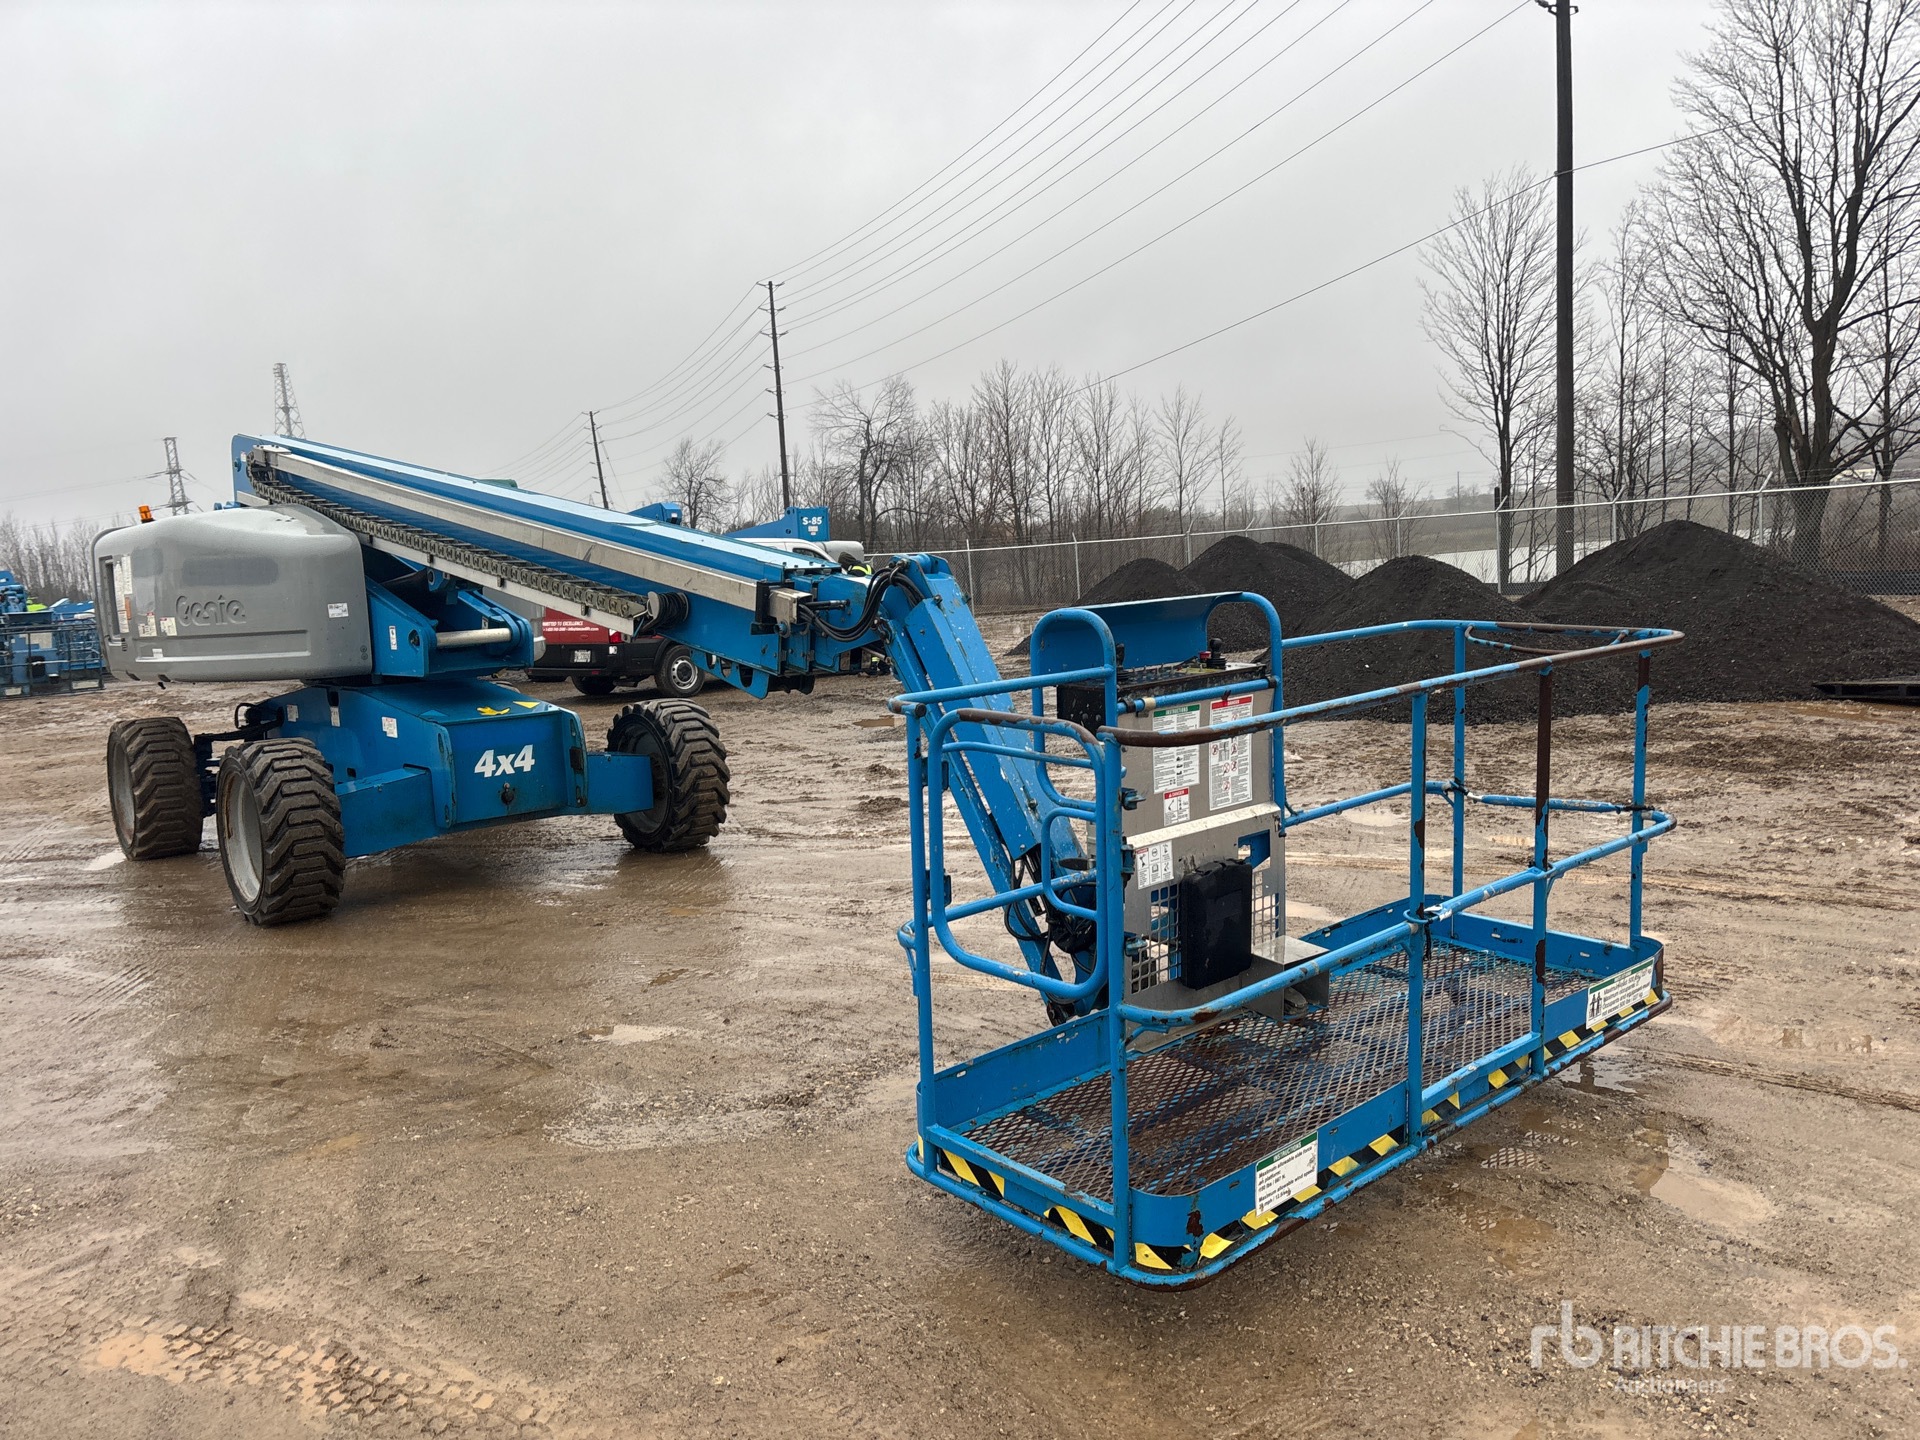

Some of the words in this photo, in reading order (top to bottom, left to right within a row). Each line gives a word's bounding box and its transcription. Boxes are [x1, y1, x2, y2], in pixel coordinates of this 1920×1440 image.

[802, 516, 822, 525] S-85
[176, 595, 246, 627] Genie
[1166, 706, 1188, 715] INSTRUCTIONS
[474, 744, 535, 778] 4x4
[1259, 1166, 1277, 1178] Maximum
[1278, 1156, 1294, 1167] allowable
[1295, 1151, 1303, 1159] side
[1303, 1146, 1312, 1154] force
[1273, 1142, 1302, 1162] INSTRUCTIONS
[1259, 1190, 1277, 1202] Maximum
[1277, 1180, 1294, 1192] allowable
[1295, 1174, 1303, 1182] wind
